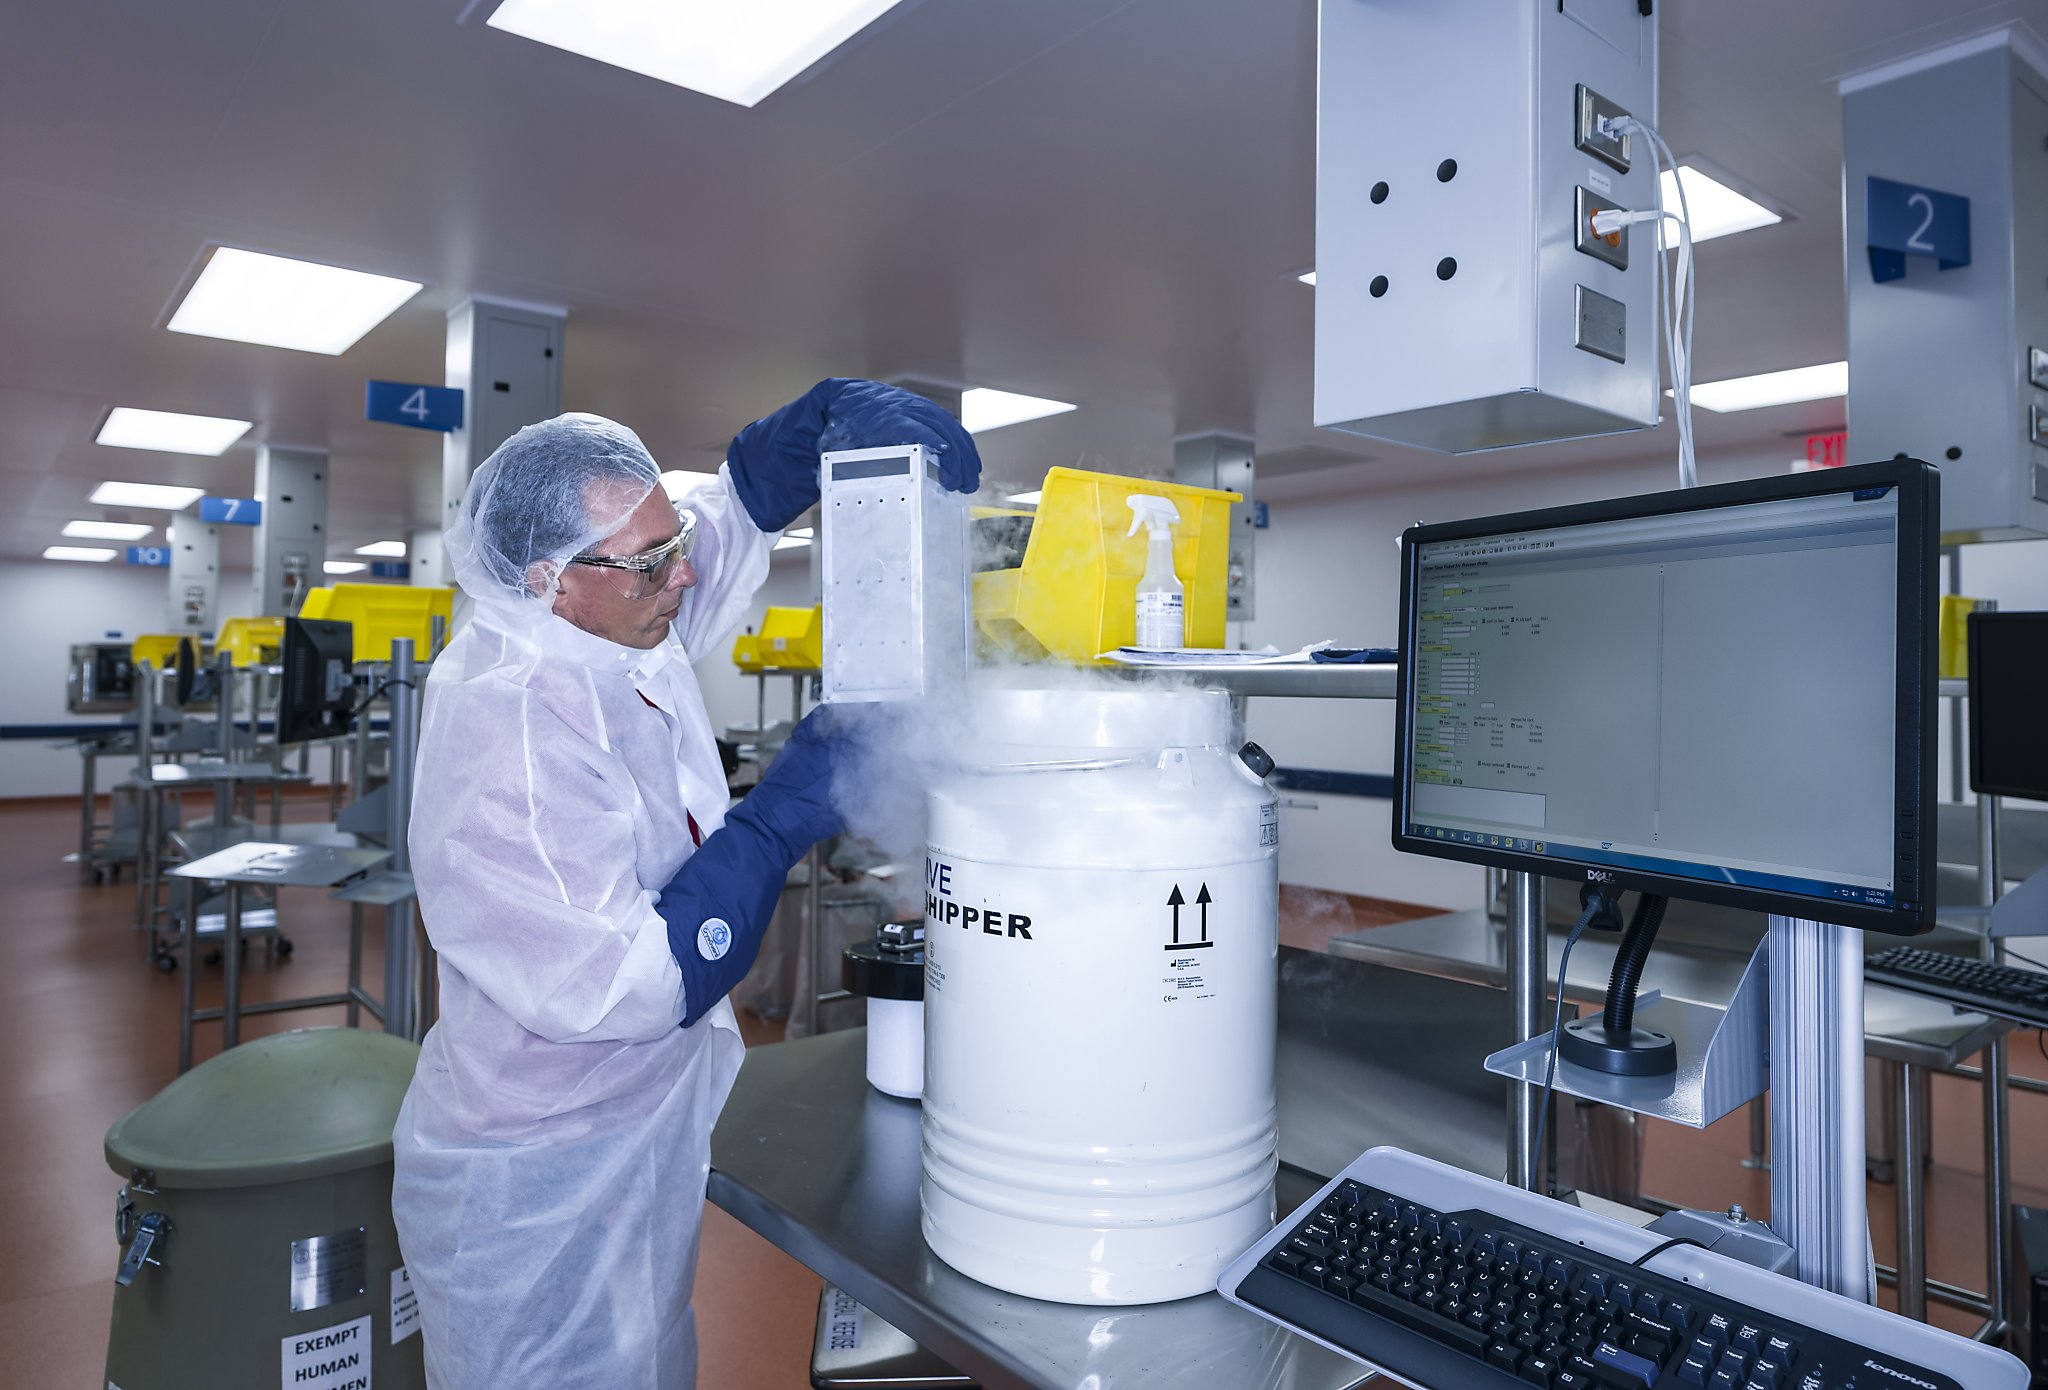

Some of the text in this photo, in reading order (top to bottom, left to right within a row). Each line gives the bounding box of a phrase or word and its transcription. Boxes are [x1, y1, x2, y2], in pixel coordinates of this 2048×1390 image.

[1907, 192, 1935, 252] 2
[400, 387, 430, 422] 4
[1807, 433, 1848, 469] EXI
[221, 498, 241, 522] 7
[136, 547, 163, 566] 10
[1587, 869, 1616, 884] DELL
[295, 1325, 360, 1355] EXEMPT
[295, 1352, 360, 1382] HUMAN
[1863, 1359, 1938, 1390] lenovo
